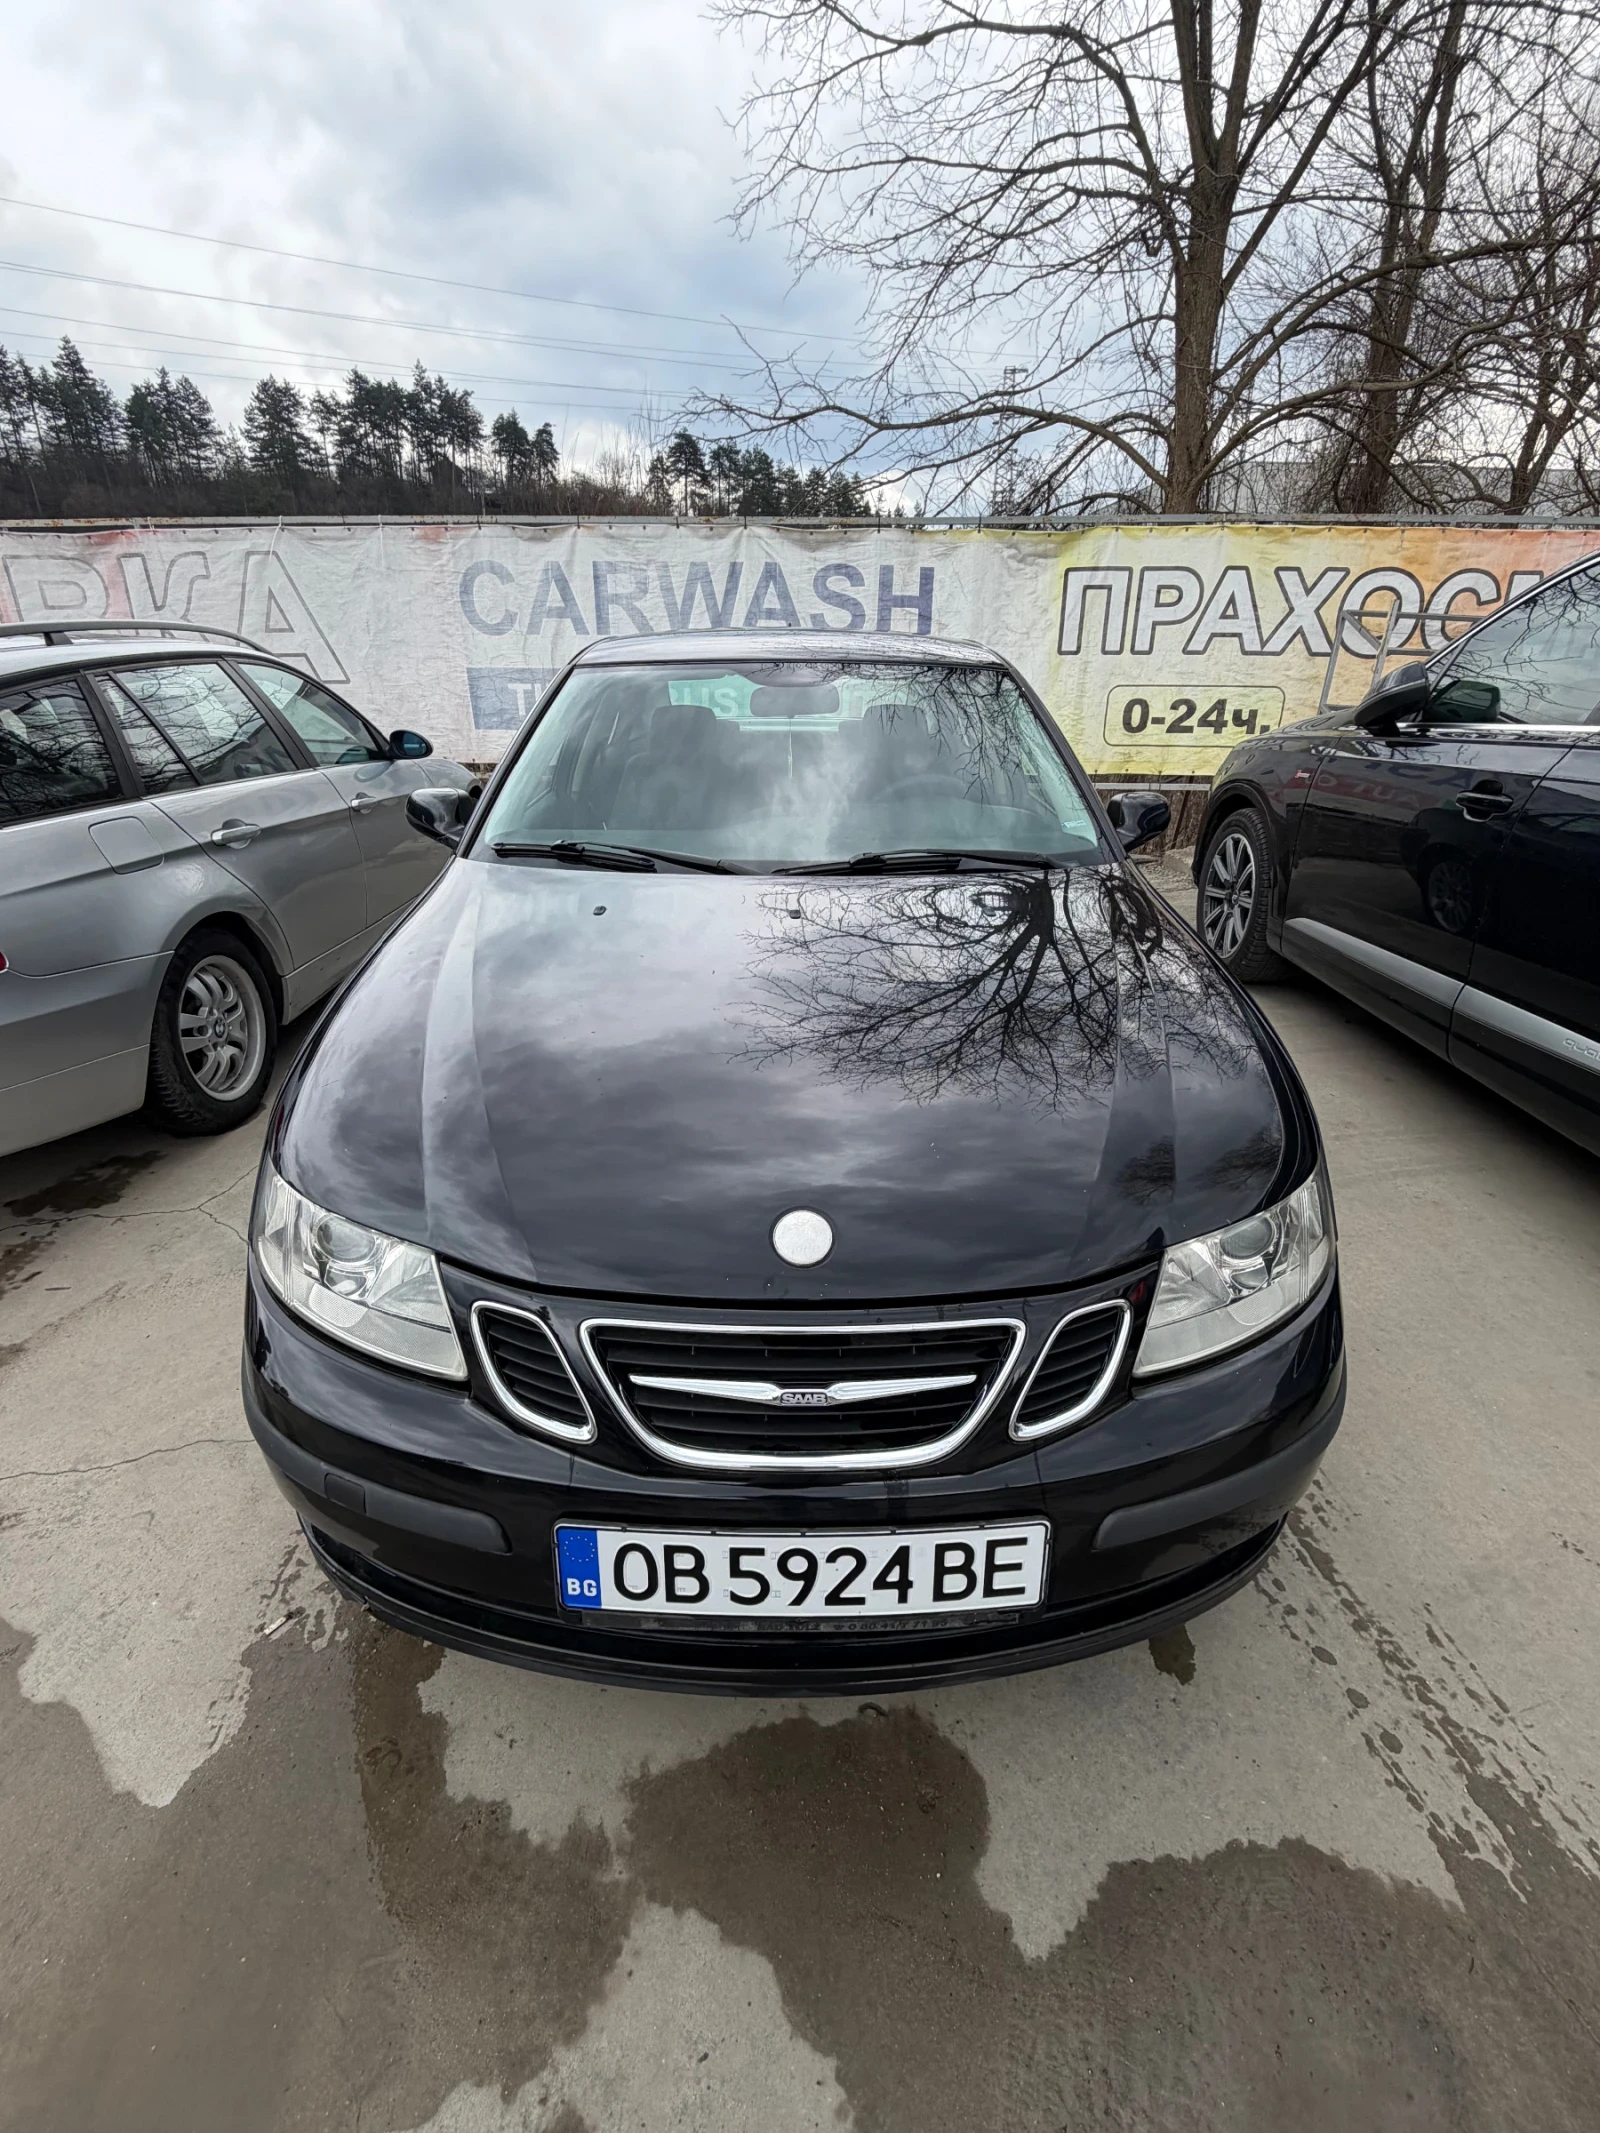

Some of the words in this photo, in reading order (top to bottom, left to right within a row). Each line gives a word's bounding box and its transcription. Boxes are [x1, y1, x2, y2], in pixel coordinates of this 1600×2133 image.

[459, 559, 935, 635] CARWASH
[1122, 698, 1271, 735] 0-24ч.
[781, 1393, 827, 1404] SAAB
[566, 1577, 597, 1597] BG
[728, 1545, 913, 1606] 5924
[932, 1537, 1028, 1602] BE
